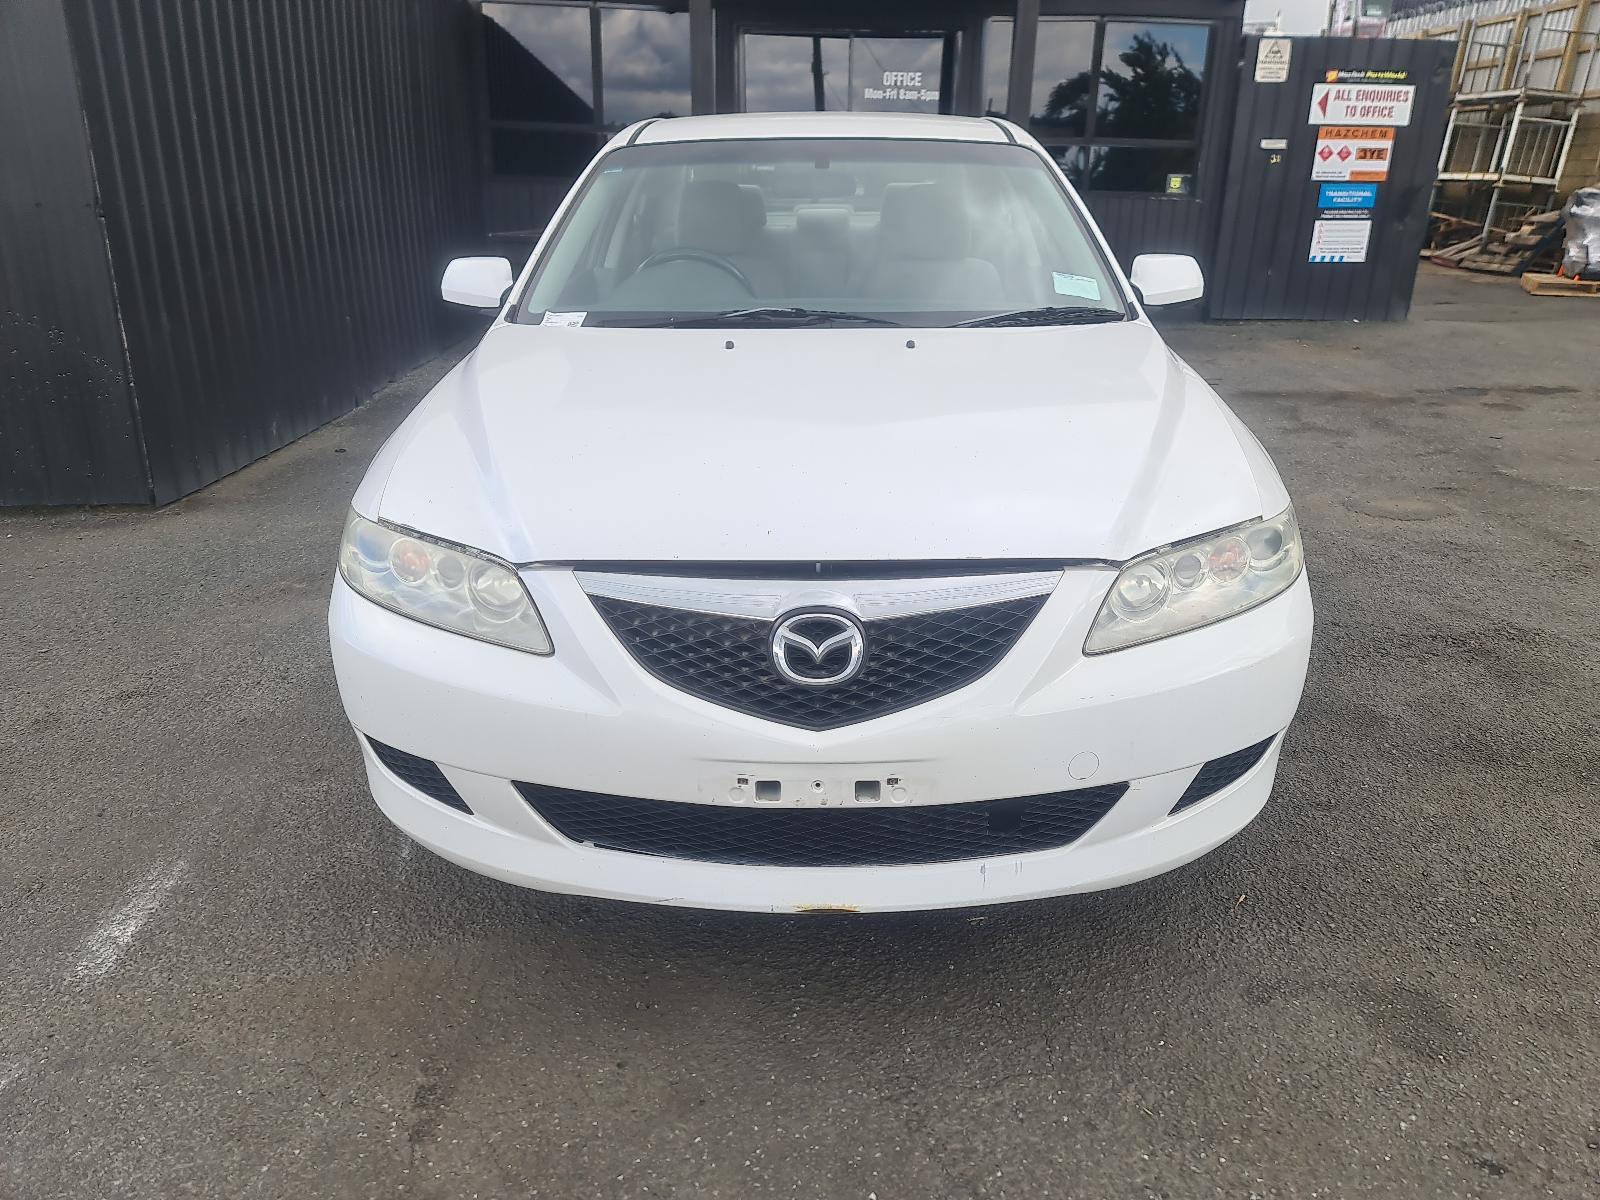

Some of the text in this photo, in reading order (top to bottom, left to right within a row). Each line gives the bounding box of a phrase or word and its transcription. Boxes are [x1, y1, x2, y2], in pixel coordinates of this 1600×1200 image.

[883, 71, 923, 86] OFFICE
[864, 88, 897, 99] Mon-Fri
[1333, 89, 1411, 103] ALL ENQUIRIES
[1344, 105, 1395, 118] TO OFFICE
[1325, 127, 1388, 138] HAZCHEM
[1359, 148, 1385, 160] 3YE
